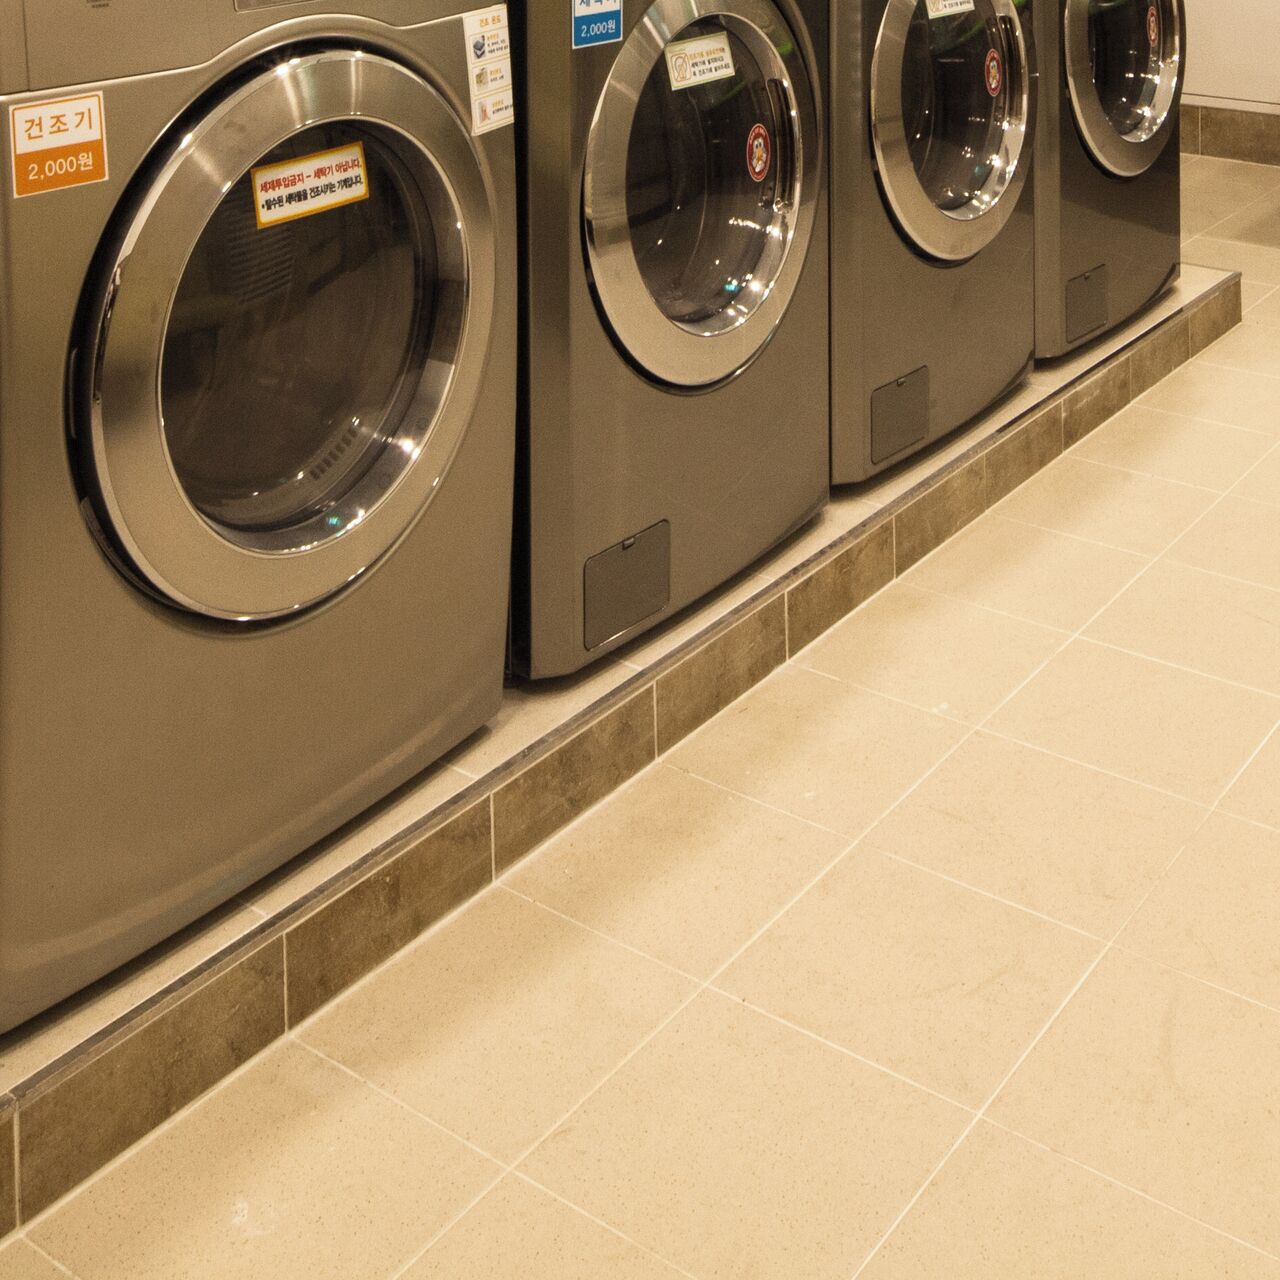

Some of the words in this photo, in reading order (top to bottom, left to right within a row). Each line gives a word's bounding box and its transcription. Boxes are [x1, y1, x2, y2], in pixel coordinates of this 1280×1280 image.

[581, 19, 617, 37] 2,000원
[24, 108, 94, 140] 건조기
[28, 151, 94, 180] 2,000원
[260, 171, 304, 193] 세제투입금지
[312, 164, 334, 179] 세탁기
[334, 157, 361, 173] 아닙니다.
